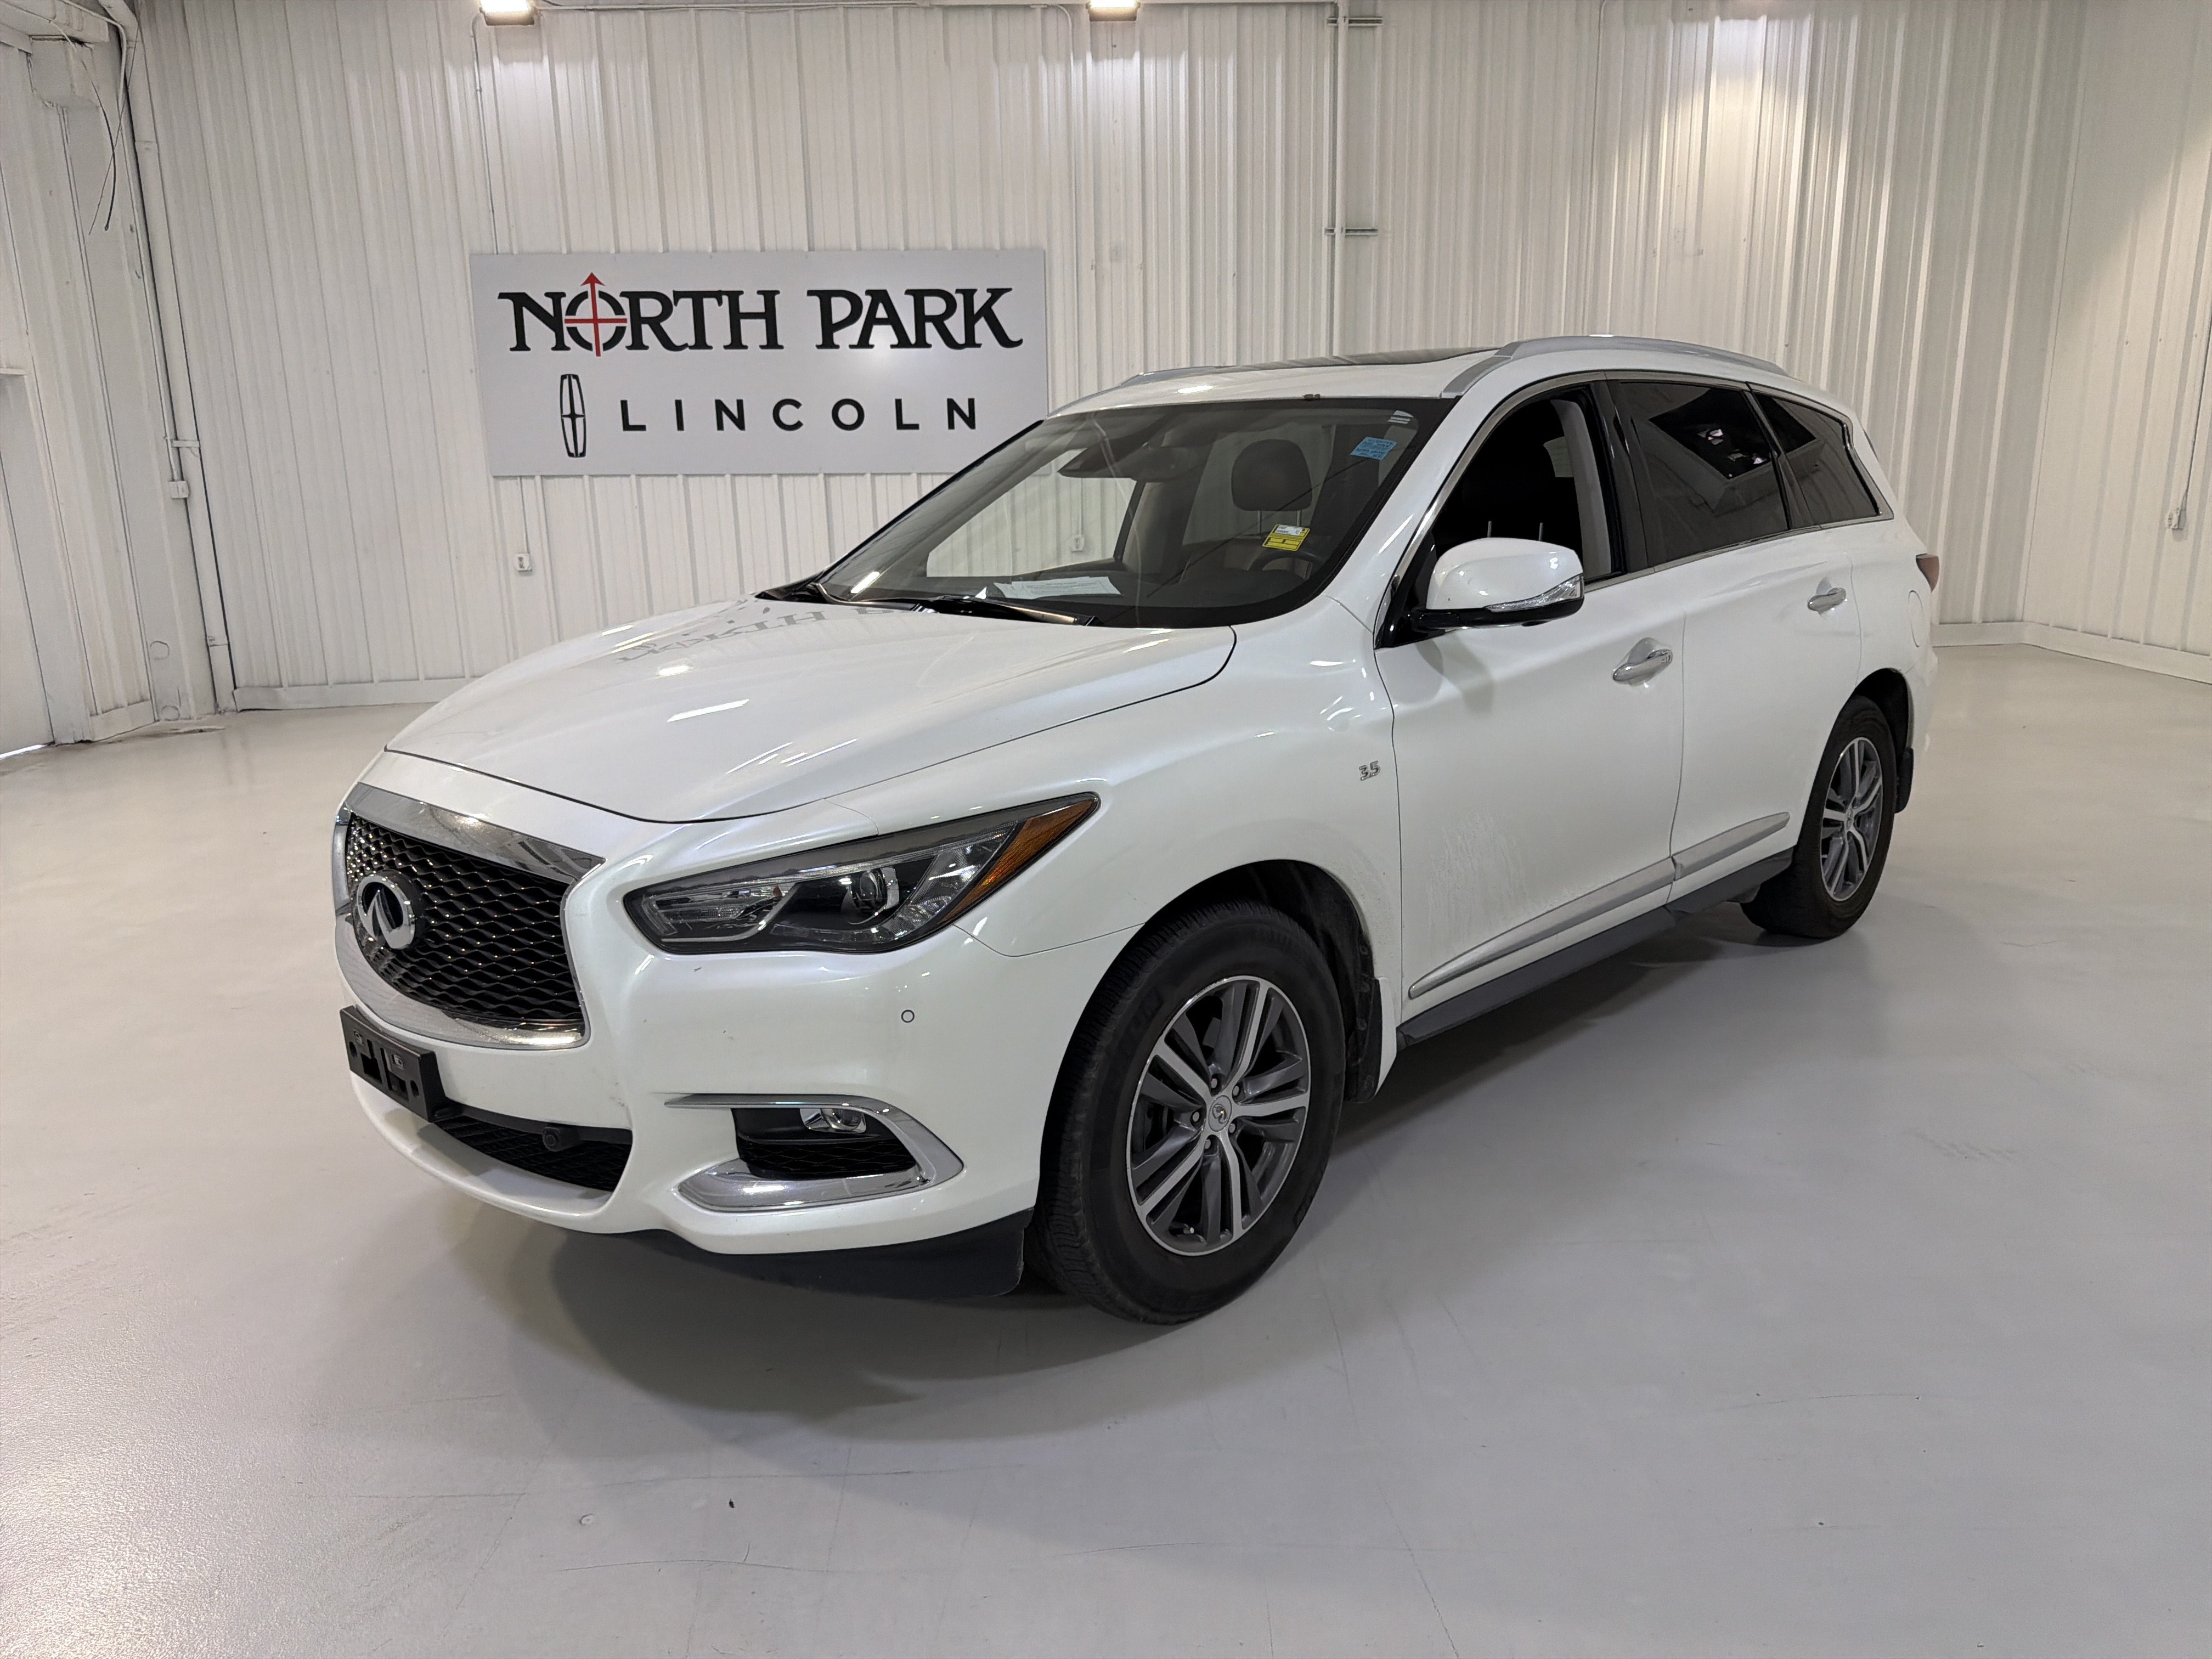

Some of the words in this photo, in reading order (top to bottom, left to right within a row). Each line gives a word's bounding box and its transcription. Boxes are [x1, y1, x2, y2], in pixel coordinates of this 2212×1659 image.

[496, 289, 785, 353] NORTH
[806, 287, 1024, 351] PARK
[619, 397, 977, 432] LINCOLN
